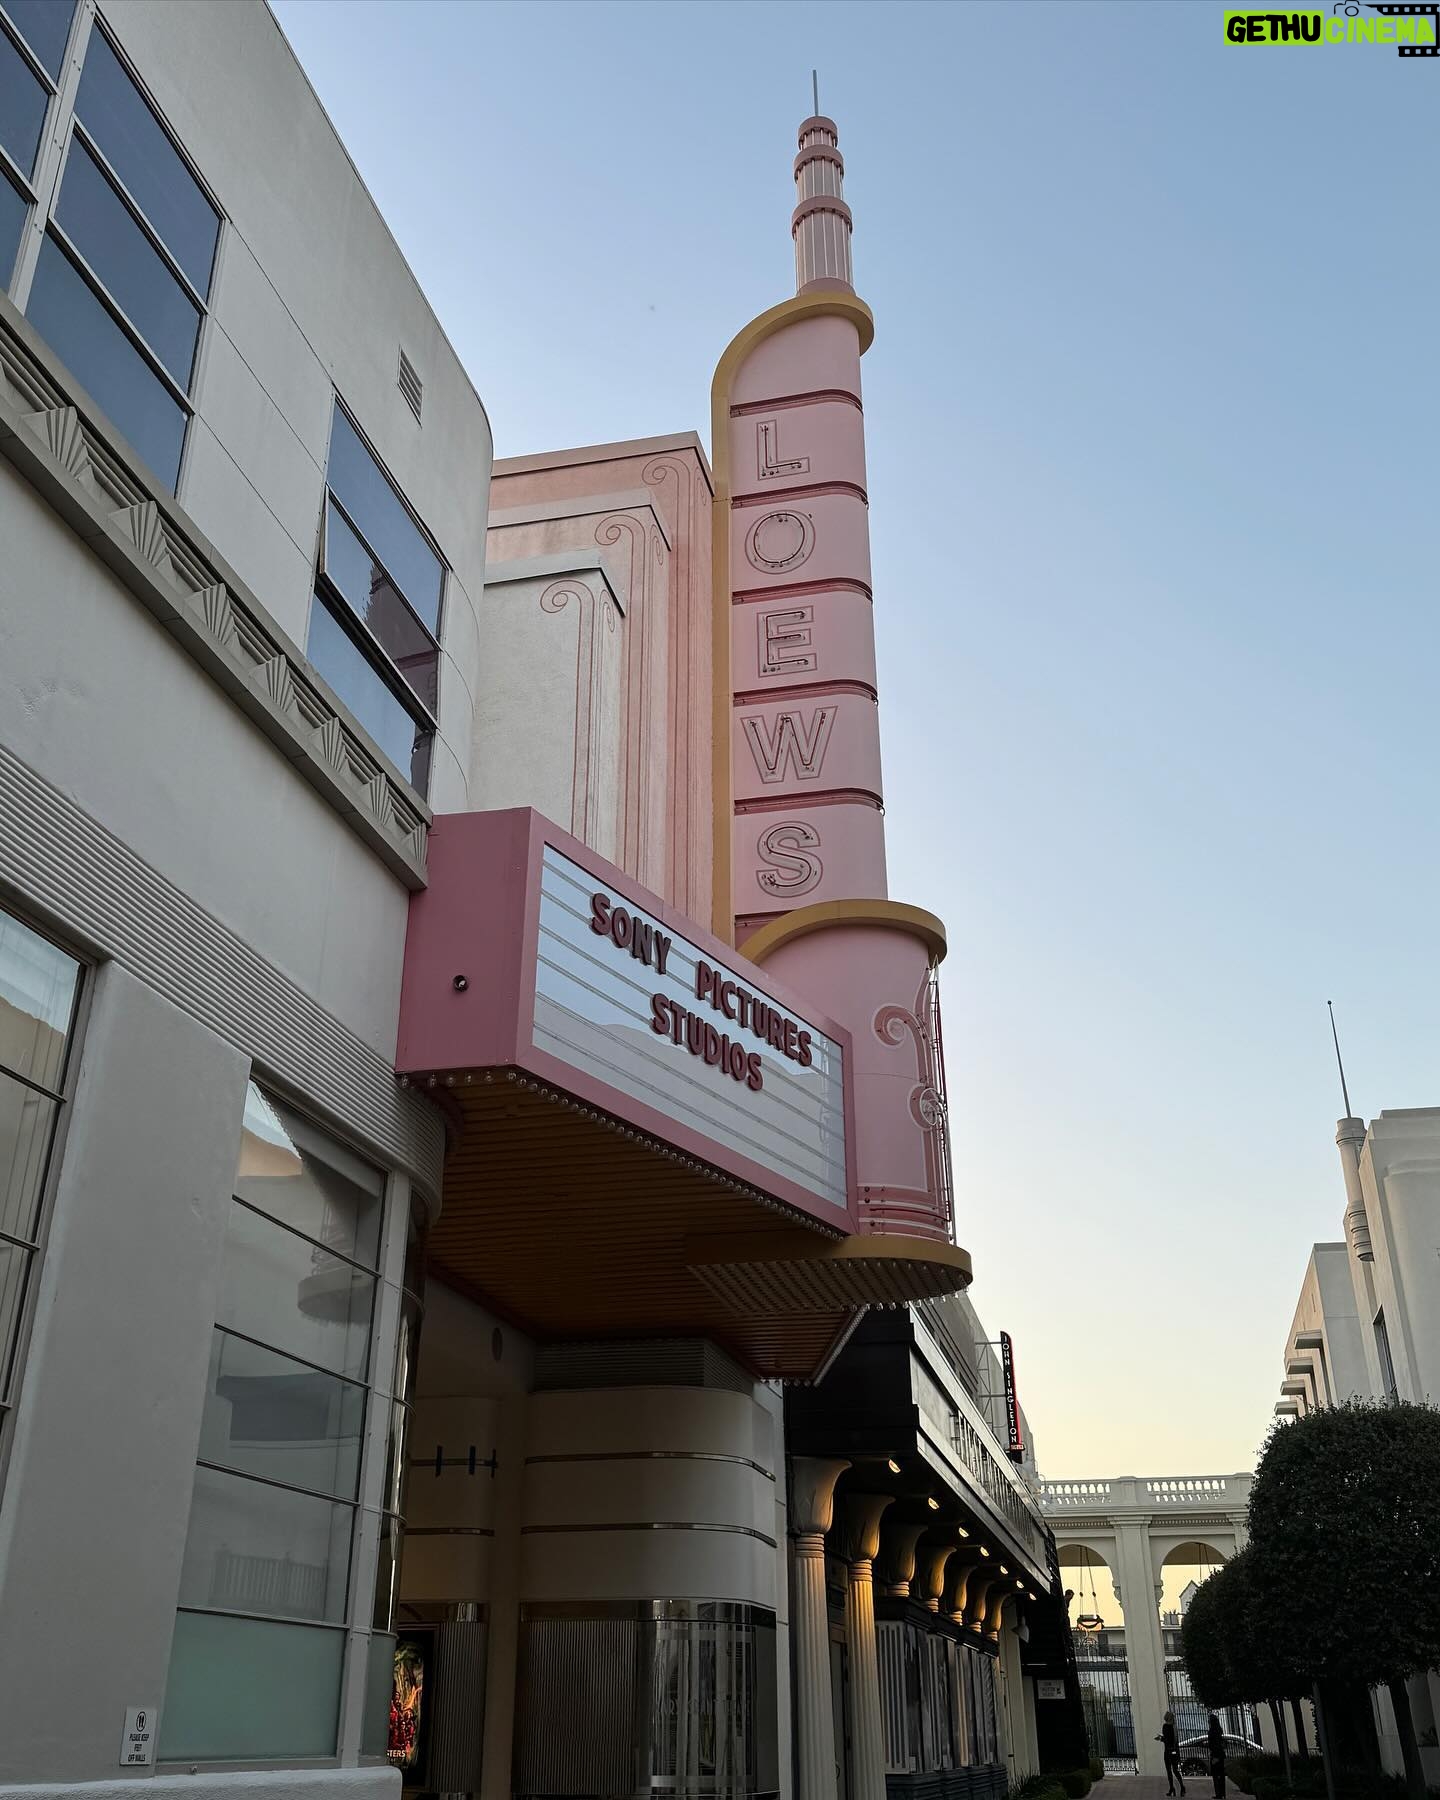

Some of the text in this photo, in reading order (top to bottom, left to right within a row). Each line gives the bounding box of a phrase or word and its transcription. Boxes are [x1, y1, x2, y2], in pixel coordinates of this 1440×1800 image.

[740, 419, 838, 898] LOEWS
[588, 892, 813, 1067] SONY PICTURES
[650, 993, 764, 1091] STUDIOS
[1006, 1371, 1018, 1443] SINGLETON
